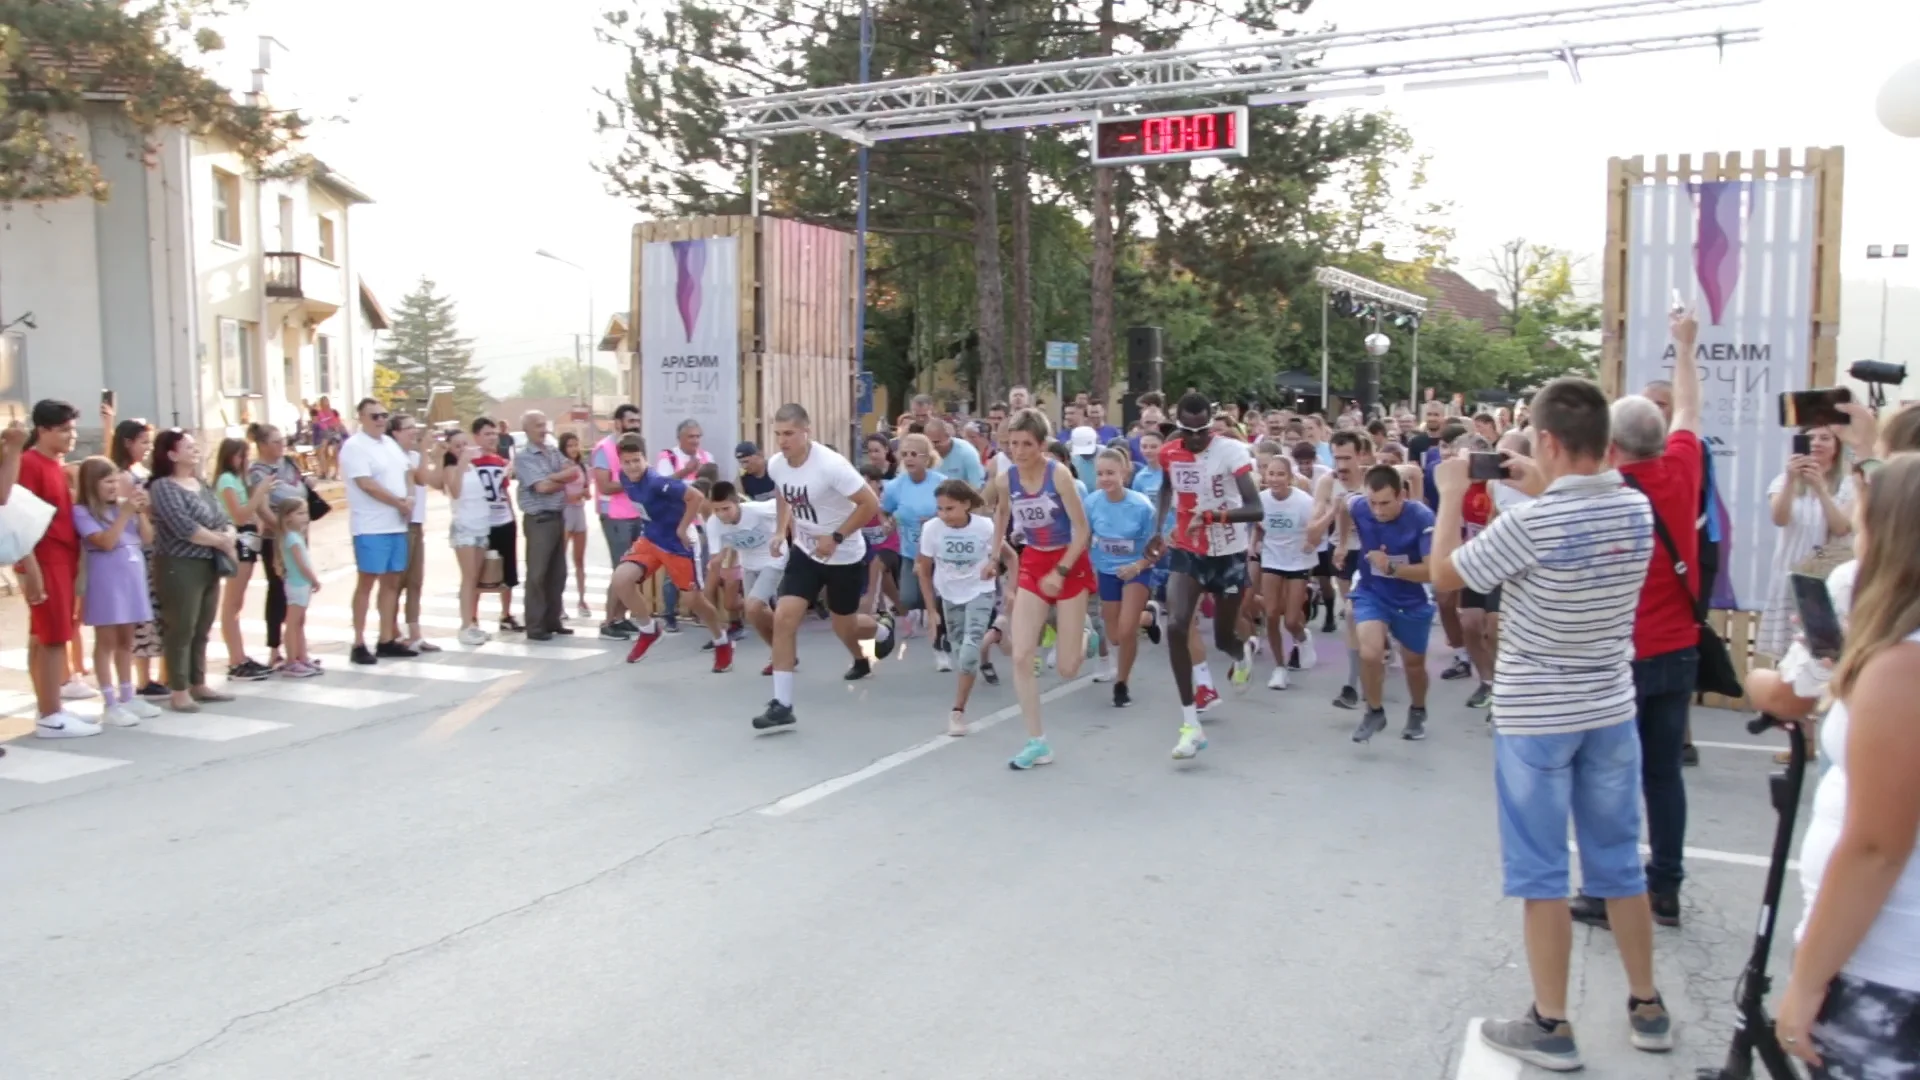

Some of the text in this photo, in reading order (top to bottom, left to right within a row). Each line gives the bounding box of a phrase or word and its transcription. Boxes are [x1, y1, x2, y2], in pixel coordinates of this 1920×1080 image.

[1662, 343, 1771, 361] АЛЕММ
[661, 371, 719, 391] ТРЧИ
[1175, 471, 1200, 485] 125
[1019, 507, 1045, 520] 128
[1269, 518, 1293, 529] 250
[946, 541, 974, 553] 206
